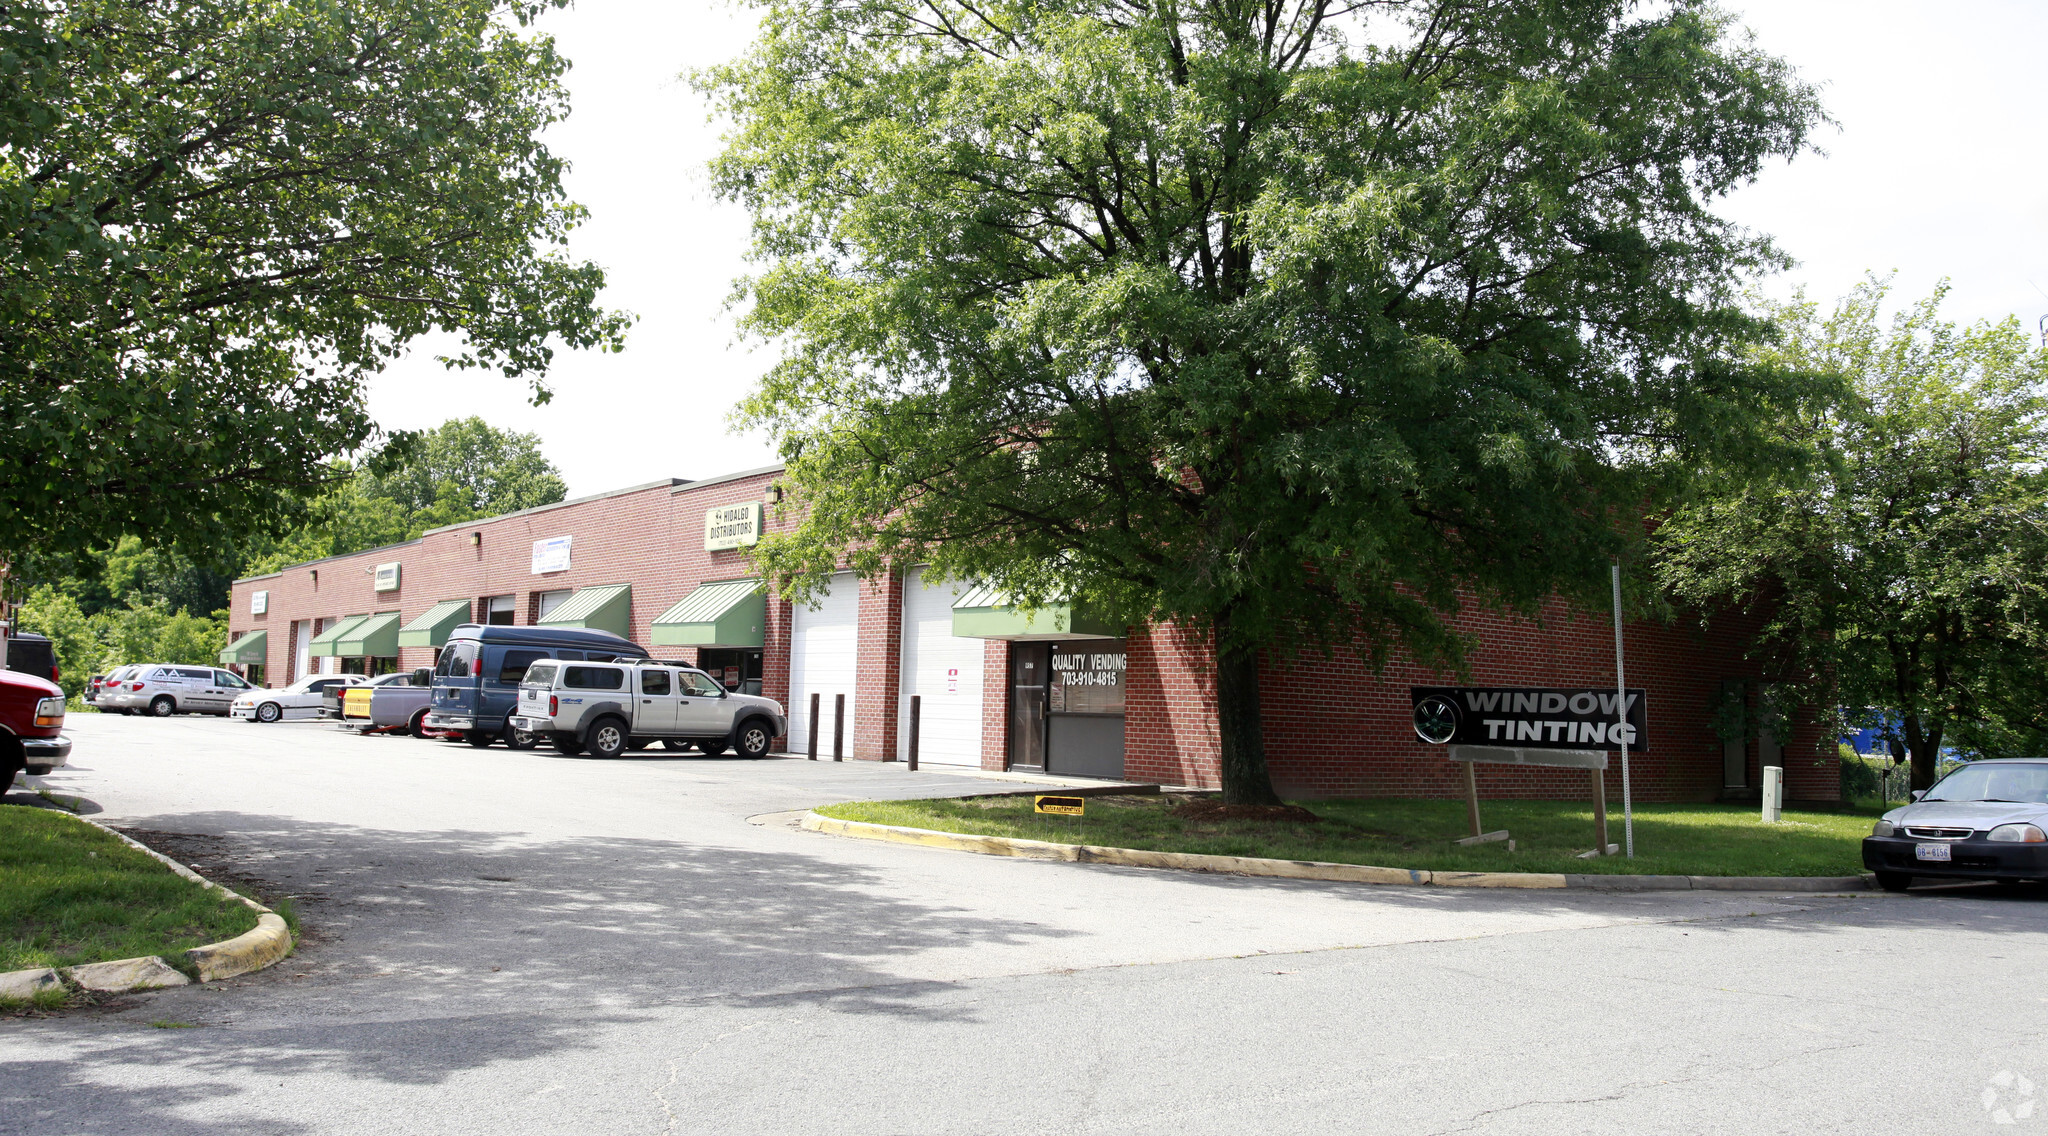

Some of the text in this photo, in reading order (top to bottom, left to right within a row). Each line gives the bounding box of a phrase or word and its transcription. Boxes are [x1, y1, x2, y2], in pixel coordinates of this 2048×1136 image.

[723, 507, 749, 523] HIDALGO
[710, 521, 752, 539] DISTRIBUTORS
[1052, 653, 1127, 671] QUALITY VENDING
[1061, 672, 1117, 686] 703-910-4815
[1465, 691, 1638, 715] WINDOW
[1483, 719, 1637, 745] TINTING
